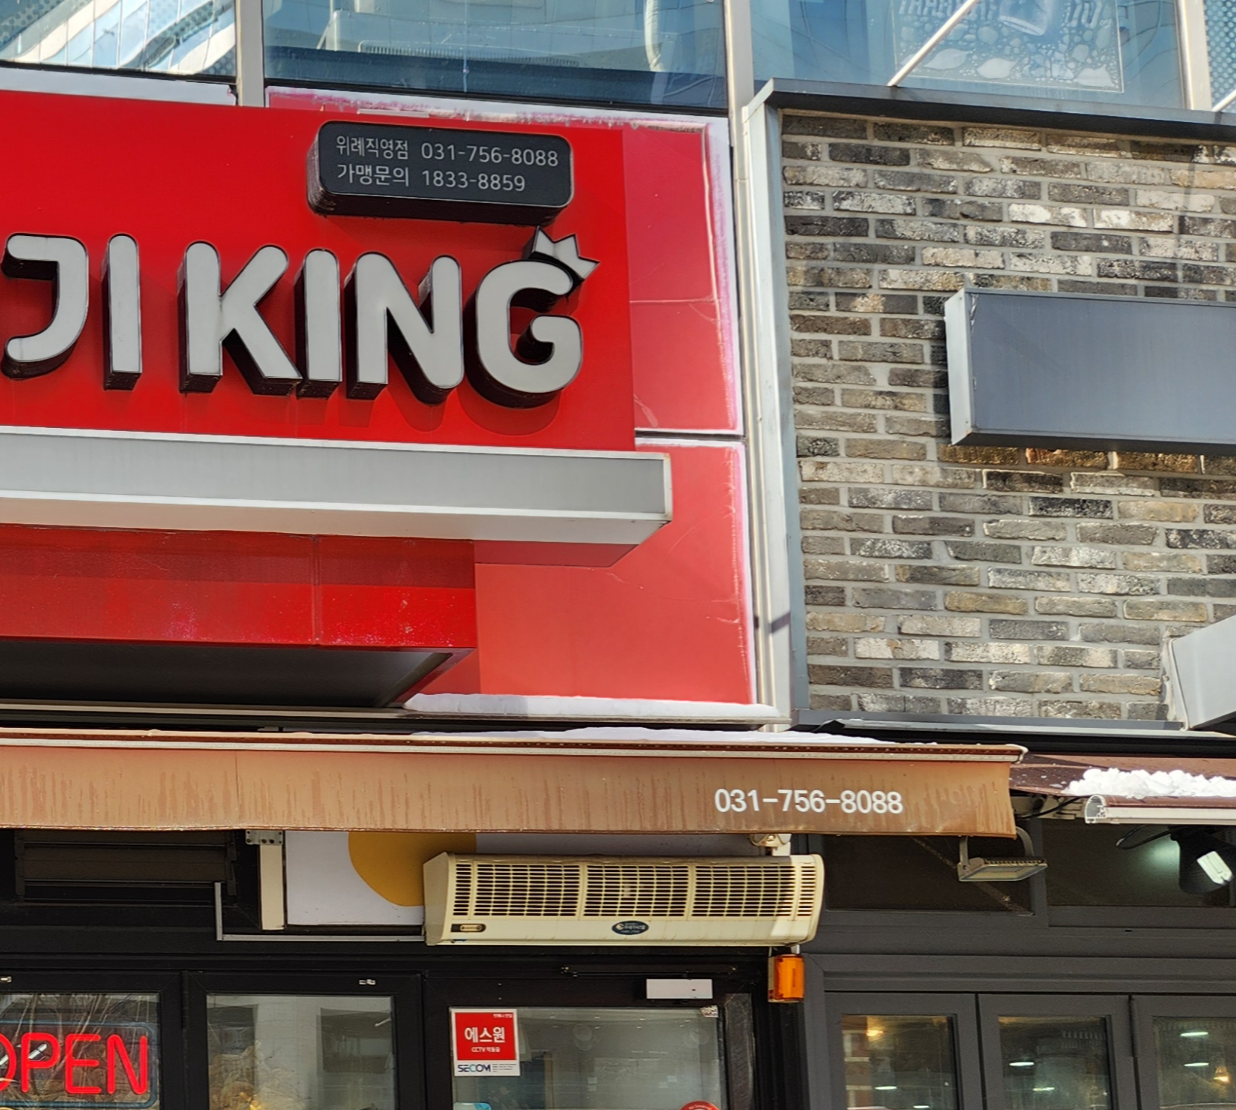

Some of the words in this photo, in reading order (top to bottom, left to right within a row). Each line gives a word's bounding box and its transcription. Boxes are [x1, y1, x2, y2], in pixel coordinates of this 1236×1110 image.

[336, 135, 408, 160] 위례직영점
[420, 142, 559, 167] 031-756-8088
[337, 164, 409, 187] 가맹문의
[421, 169, 526, 192] 1833-8859
[178, 238, 584, 403] KING
[714, 788, 904, 814] 031-756-8088
[464, 1026, 506, 1043] 에스원
[457, 1063, 492, 1073] SECOM
